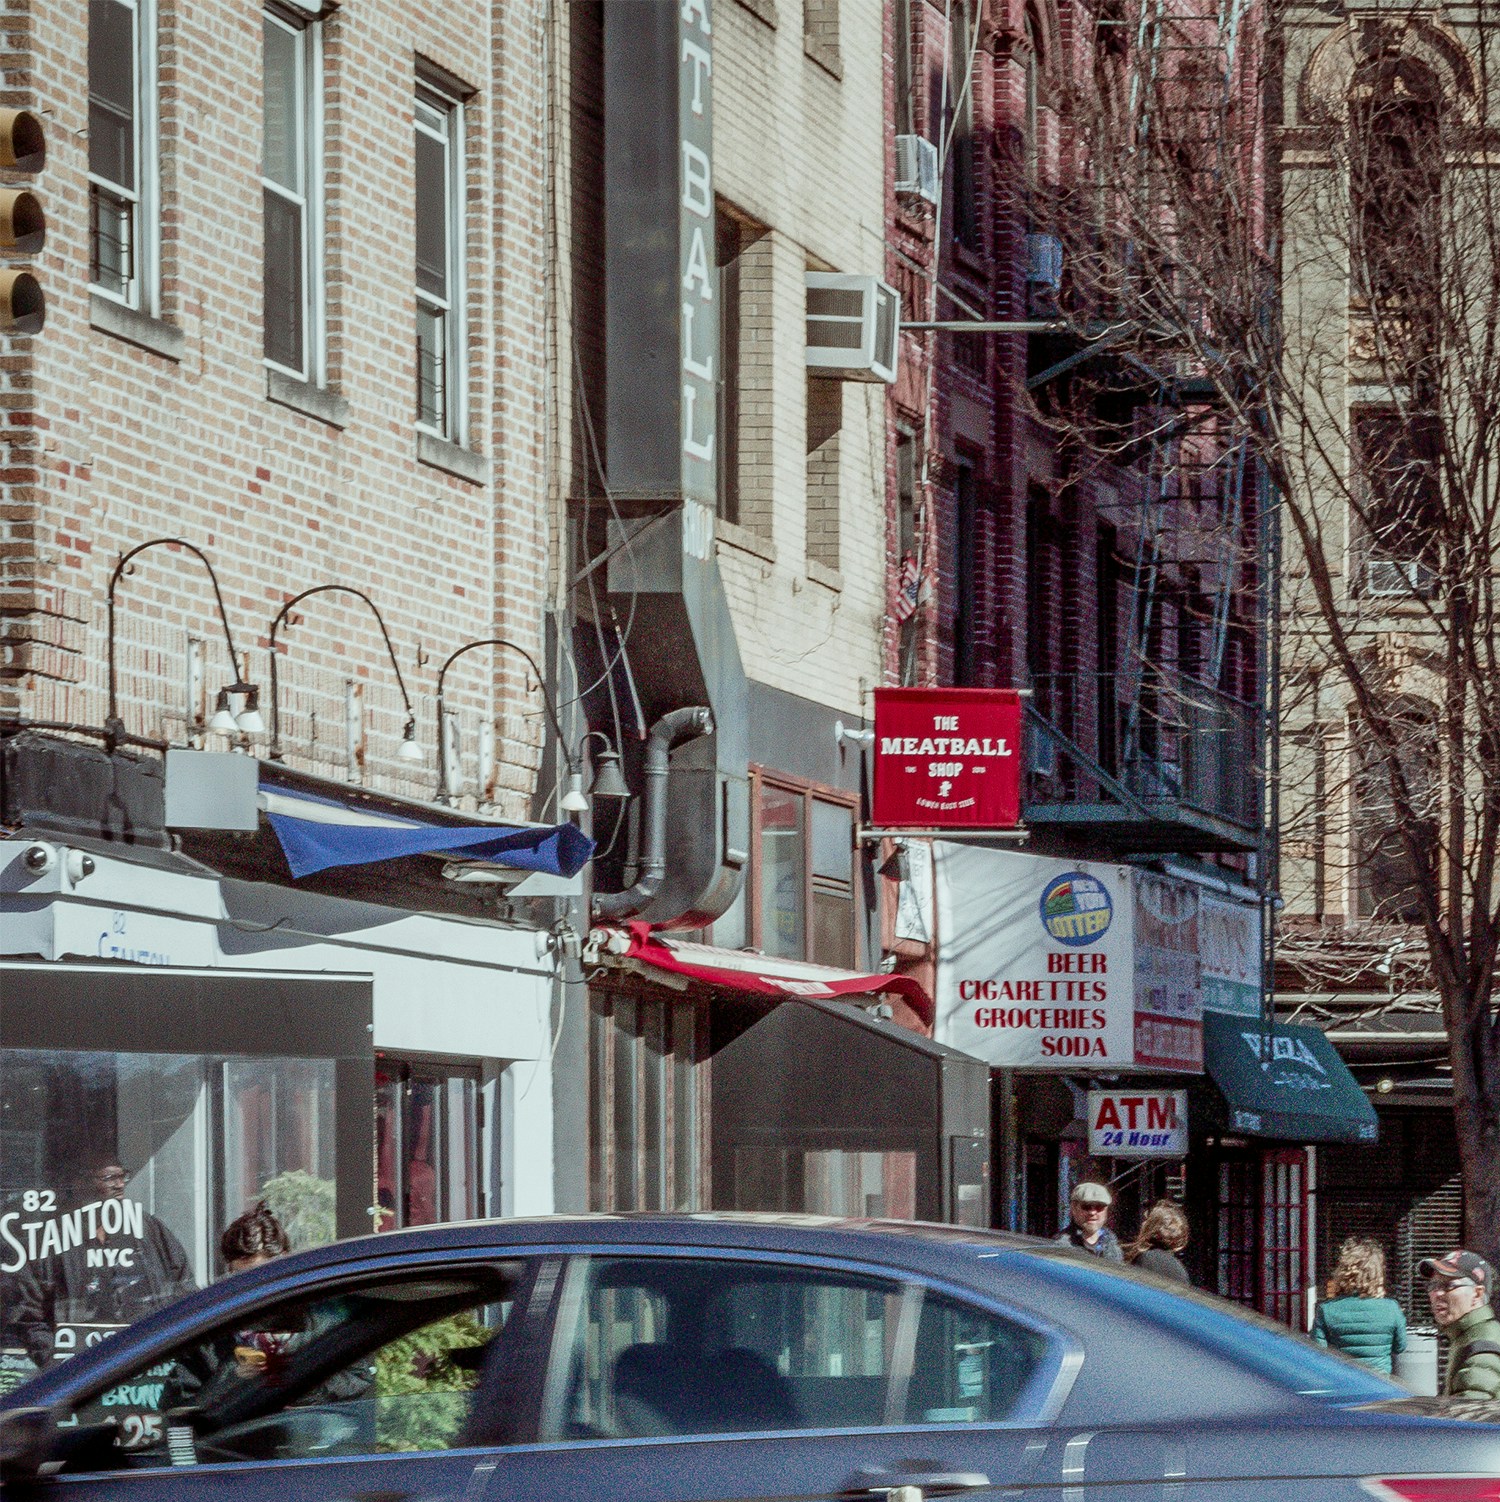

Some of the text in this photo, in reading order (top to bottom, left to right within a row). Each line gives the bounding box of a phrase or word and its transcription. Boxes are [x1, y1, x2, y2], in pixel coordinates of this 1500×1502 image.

[933, 716, 959, 731] THE
[881, 737, 1012, 756] MEATBALL
[928, 762, 963, 777] SHOP
[1048, 953, 1107, 974] BEER
[959, 980, 1107, 1001] CIGARETTES
[974, 1008, 1106, 1029] GROCERIES
[1041, 1036, 1108, 1057] SODA
[1095, 1097, 1176, 1130] ATM
[1102, 1132, 1170, 1147] 24 Hour
[23, 1190, 57, 1212] 82
[0, 1198, 144, 1273] STANTON
[87, 1248, 134, 1268] NYC
